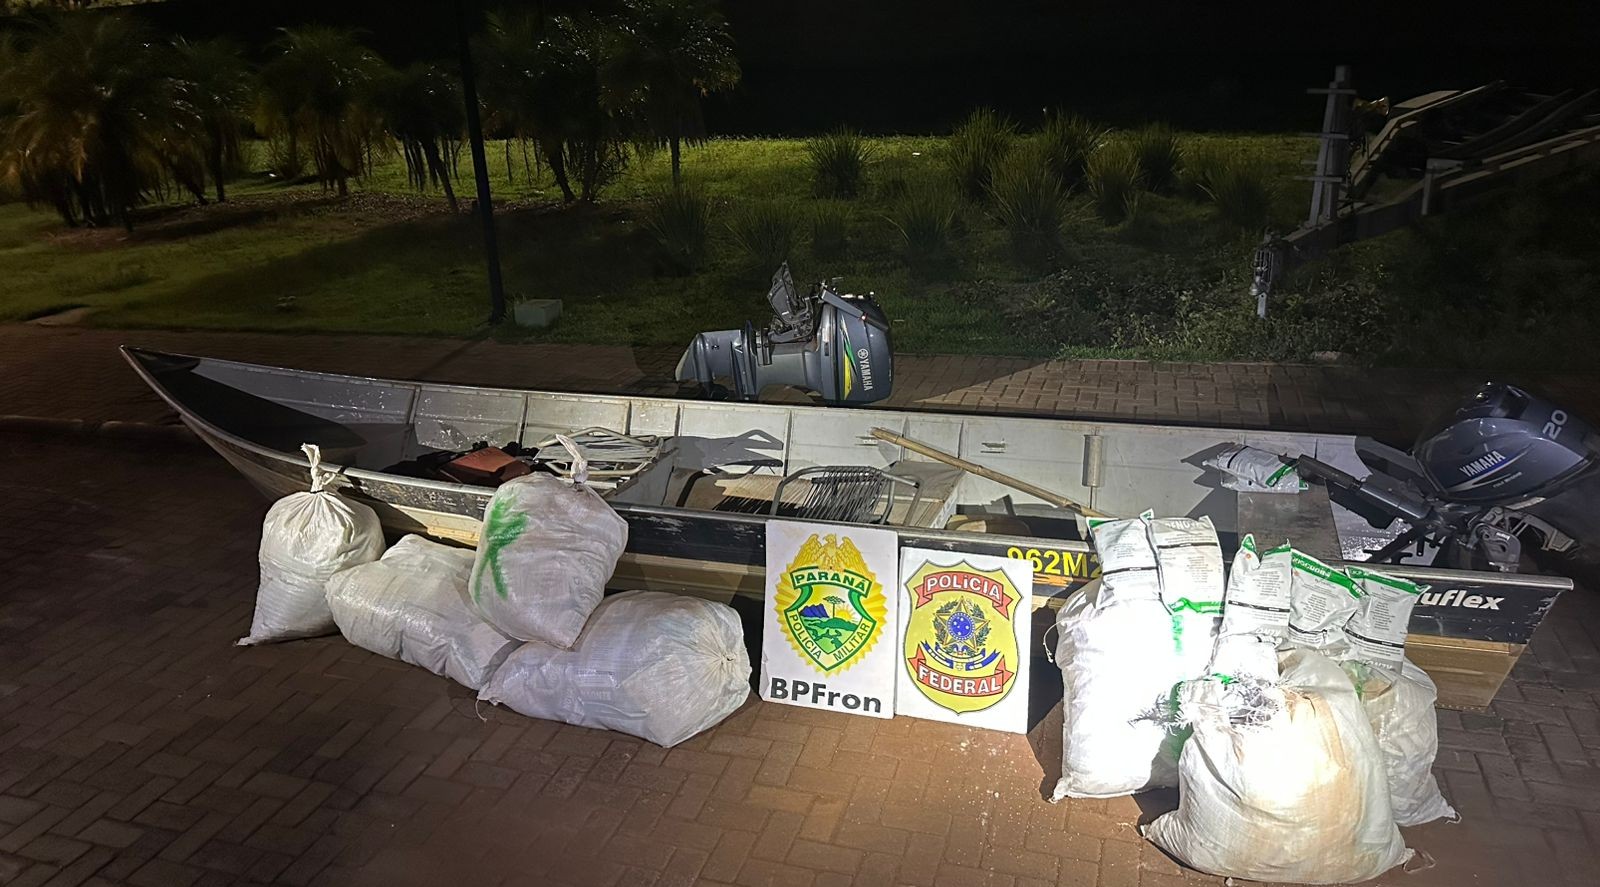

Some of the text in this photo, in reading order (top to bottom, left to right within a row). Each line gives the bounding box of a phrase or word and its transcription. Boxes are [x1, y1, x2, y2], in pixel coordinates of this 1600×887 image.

[859, 358, 874, 391] YAMAHA
[1542, 409, 1568, 440] 20
[1459, 450, 1506, 477] YAMAHA
[794, 571, 866, 592] PARANÁ
[1414, 589, 1505, 611] uflex
[832, 623, 871, 662] MILITAR
[770, 677, 882, 713] BPFron
[918, 664, 1002, 695] FEDERAL
